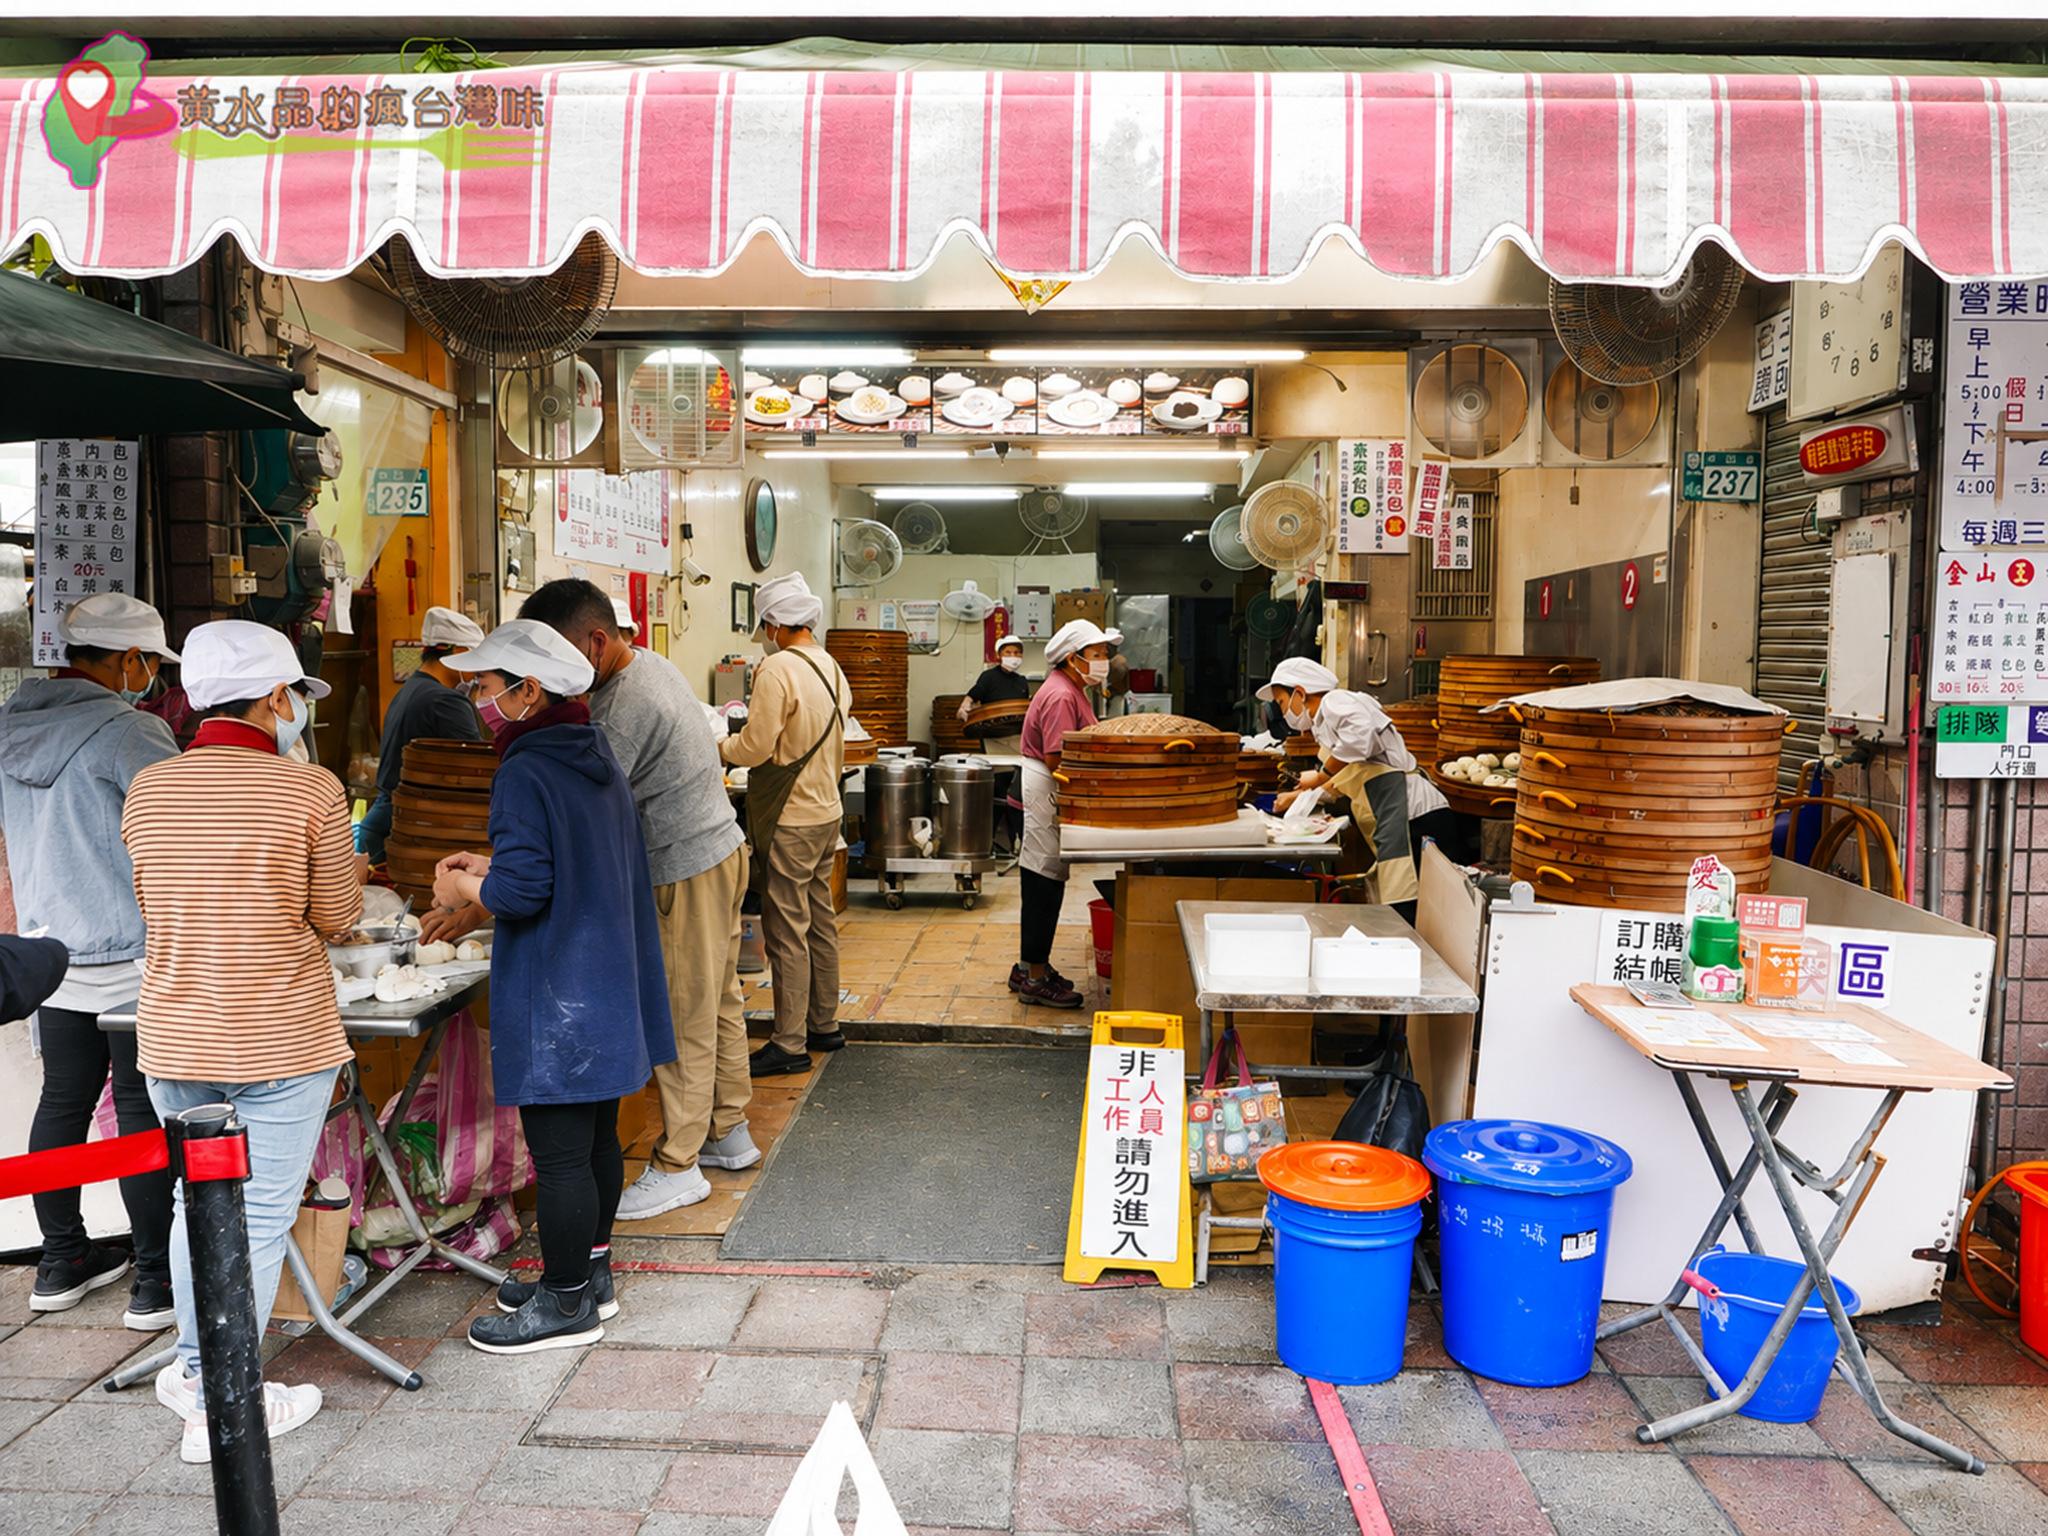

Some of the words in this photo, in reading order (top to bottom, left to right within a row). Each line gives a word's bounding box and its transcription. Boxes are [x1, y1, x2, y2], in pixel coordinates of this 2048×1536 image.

[1965, 328, 1991, 378] 早上
[1961, 384, 2001, 399] 5:00
[2005, 377, 2026, 422] 假日
[1962, 422, 1987, 472] 下午
[1706, 470, 1754, 496] 237
[1957, 480, 1995, 494] 4:00
[380, 486, 423, 511] 235
[1962, 520, 2045, 545] 每週三
[73, 563, 104, 576] 20元
[1543, 586, 1549, 615] 1
[1624, 569, 1635, 605] 2
[1945, 711, 2000, 736] 排隊
[2001, 745, 2031, 759] 門口
[1617, 919, 1684, 952] 訂購
[1613, 953, 1682, 985] 結帳
[1838, 942, 1890, 998] 區
[1110, 1137, 1152, 1258] 請勿進入
